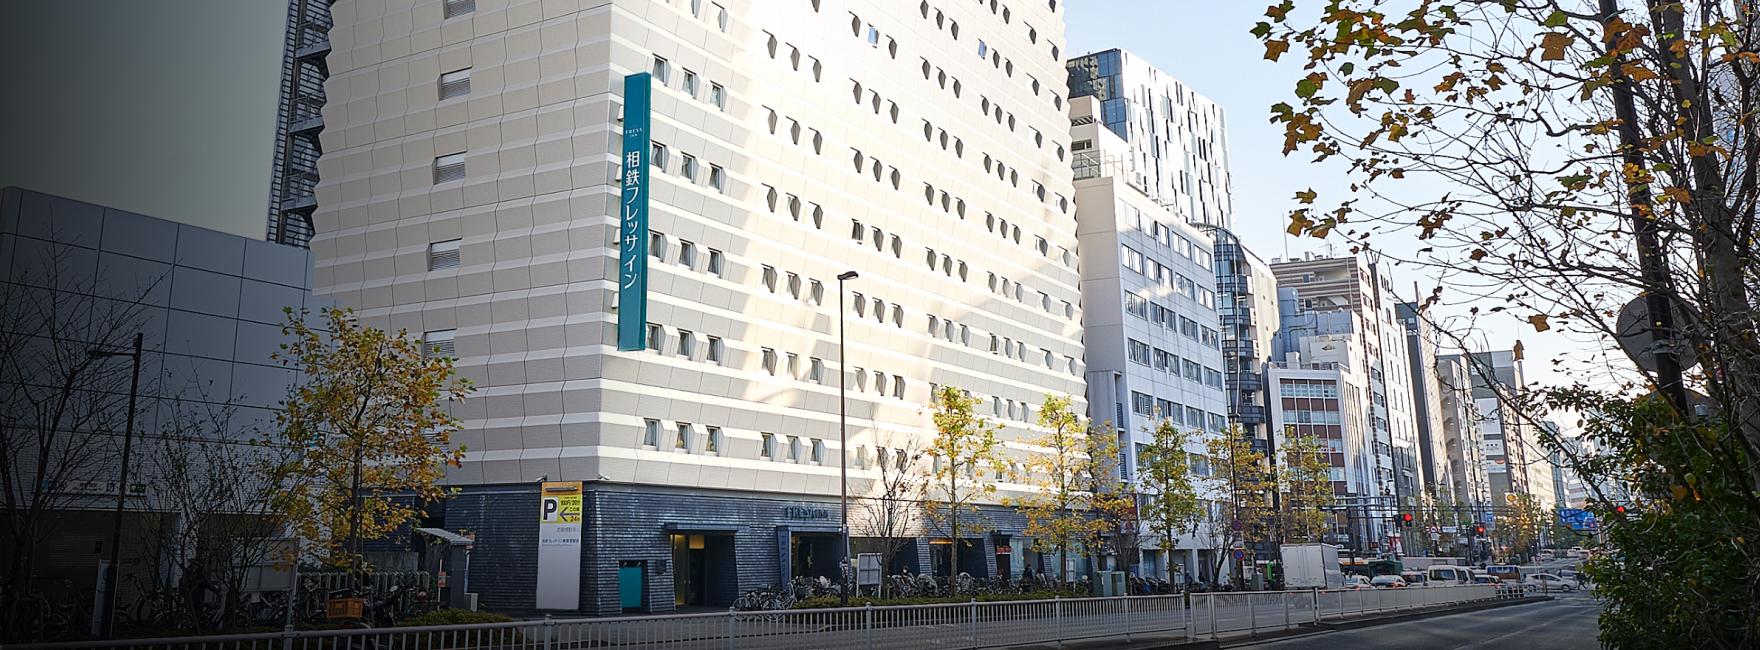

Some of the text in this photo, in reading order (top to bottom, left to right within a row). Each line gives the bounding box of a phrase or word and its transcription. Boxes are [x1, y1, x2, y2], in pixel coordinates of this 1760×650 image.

[624, 150, 640, 289] 相鉄フレッサイン
[543, 499, 558, 520] P
